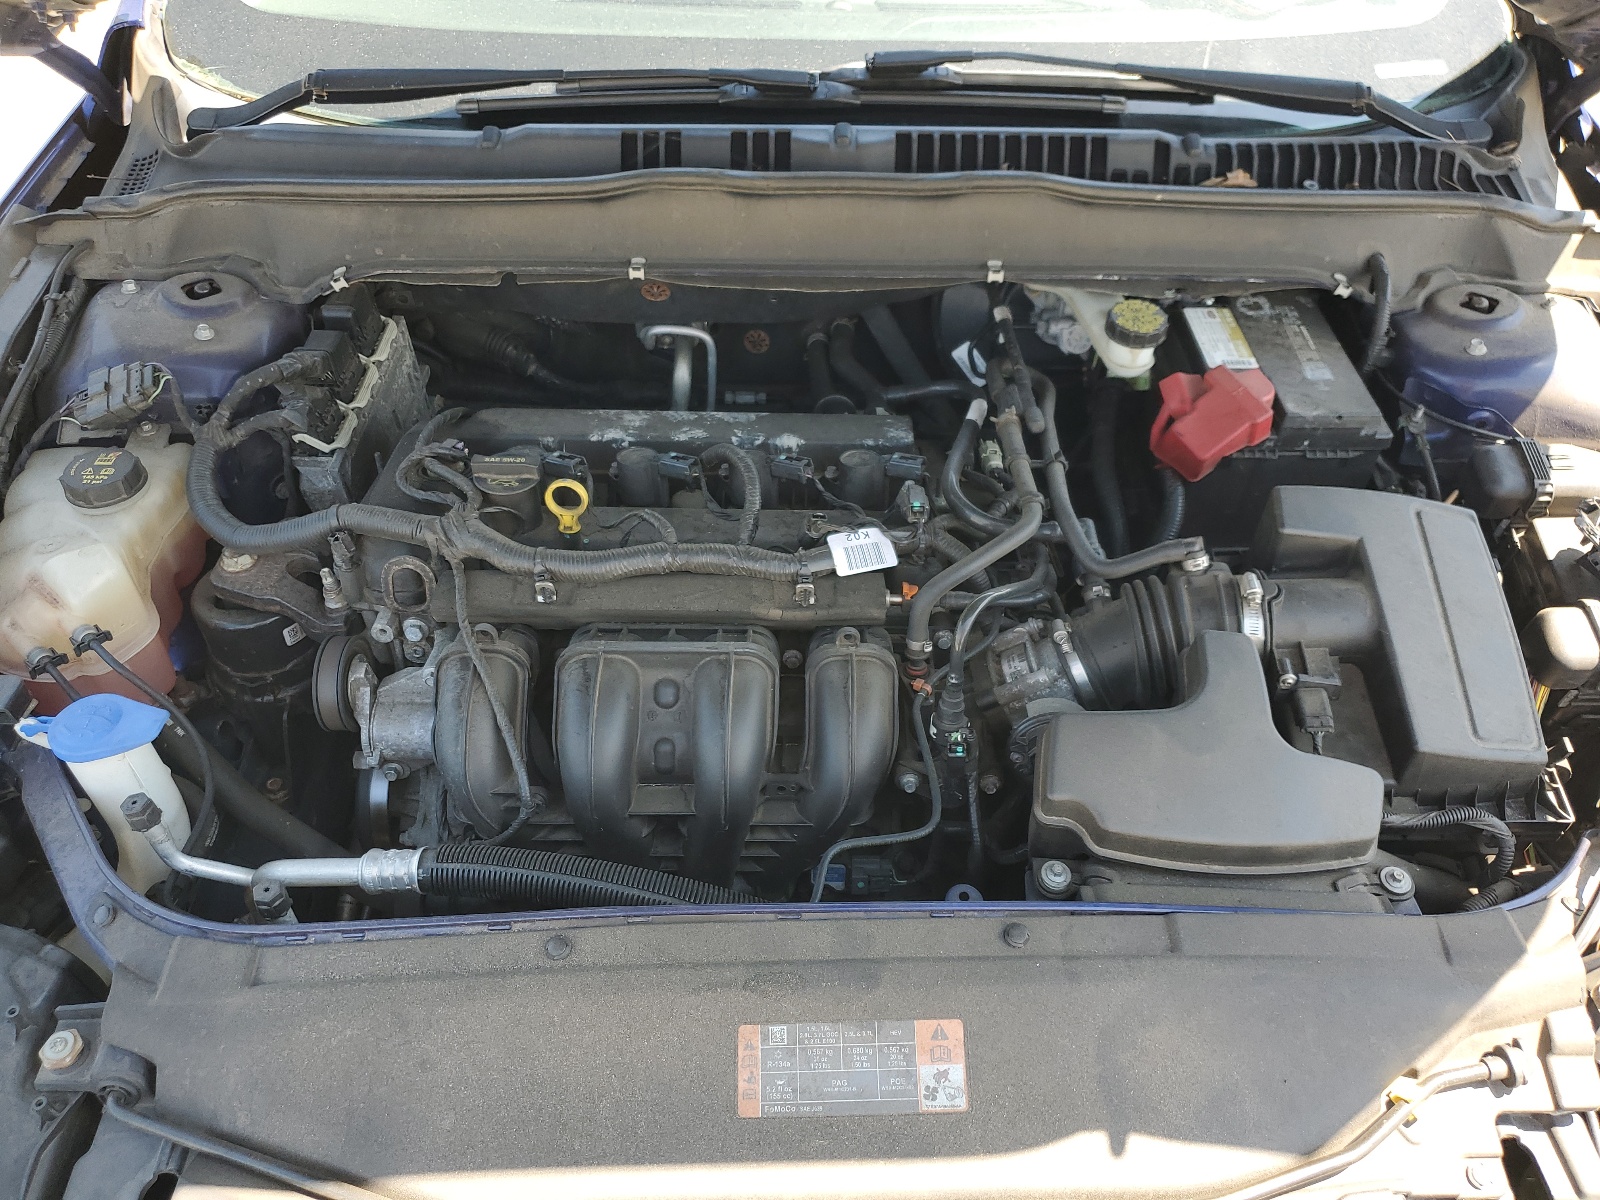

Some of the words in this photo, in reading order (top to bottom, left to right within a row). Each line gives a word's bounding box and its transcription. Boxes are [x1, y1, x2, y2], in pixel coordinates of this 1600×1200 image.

[831, 1079, 848, 1087] PAG
[890, 1077, 906, 1085] POE
[764, 1105, 796, 1113] FoMoCo
